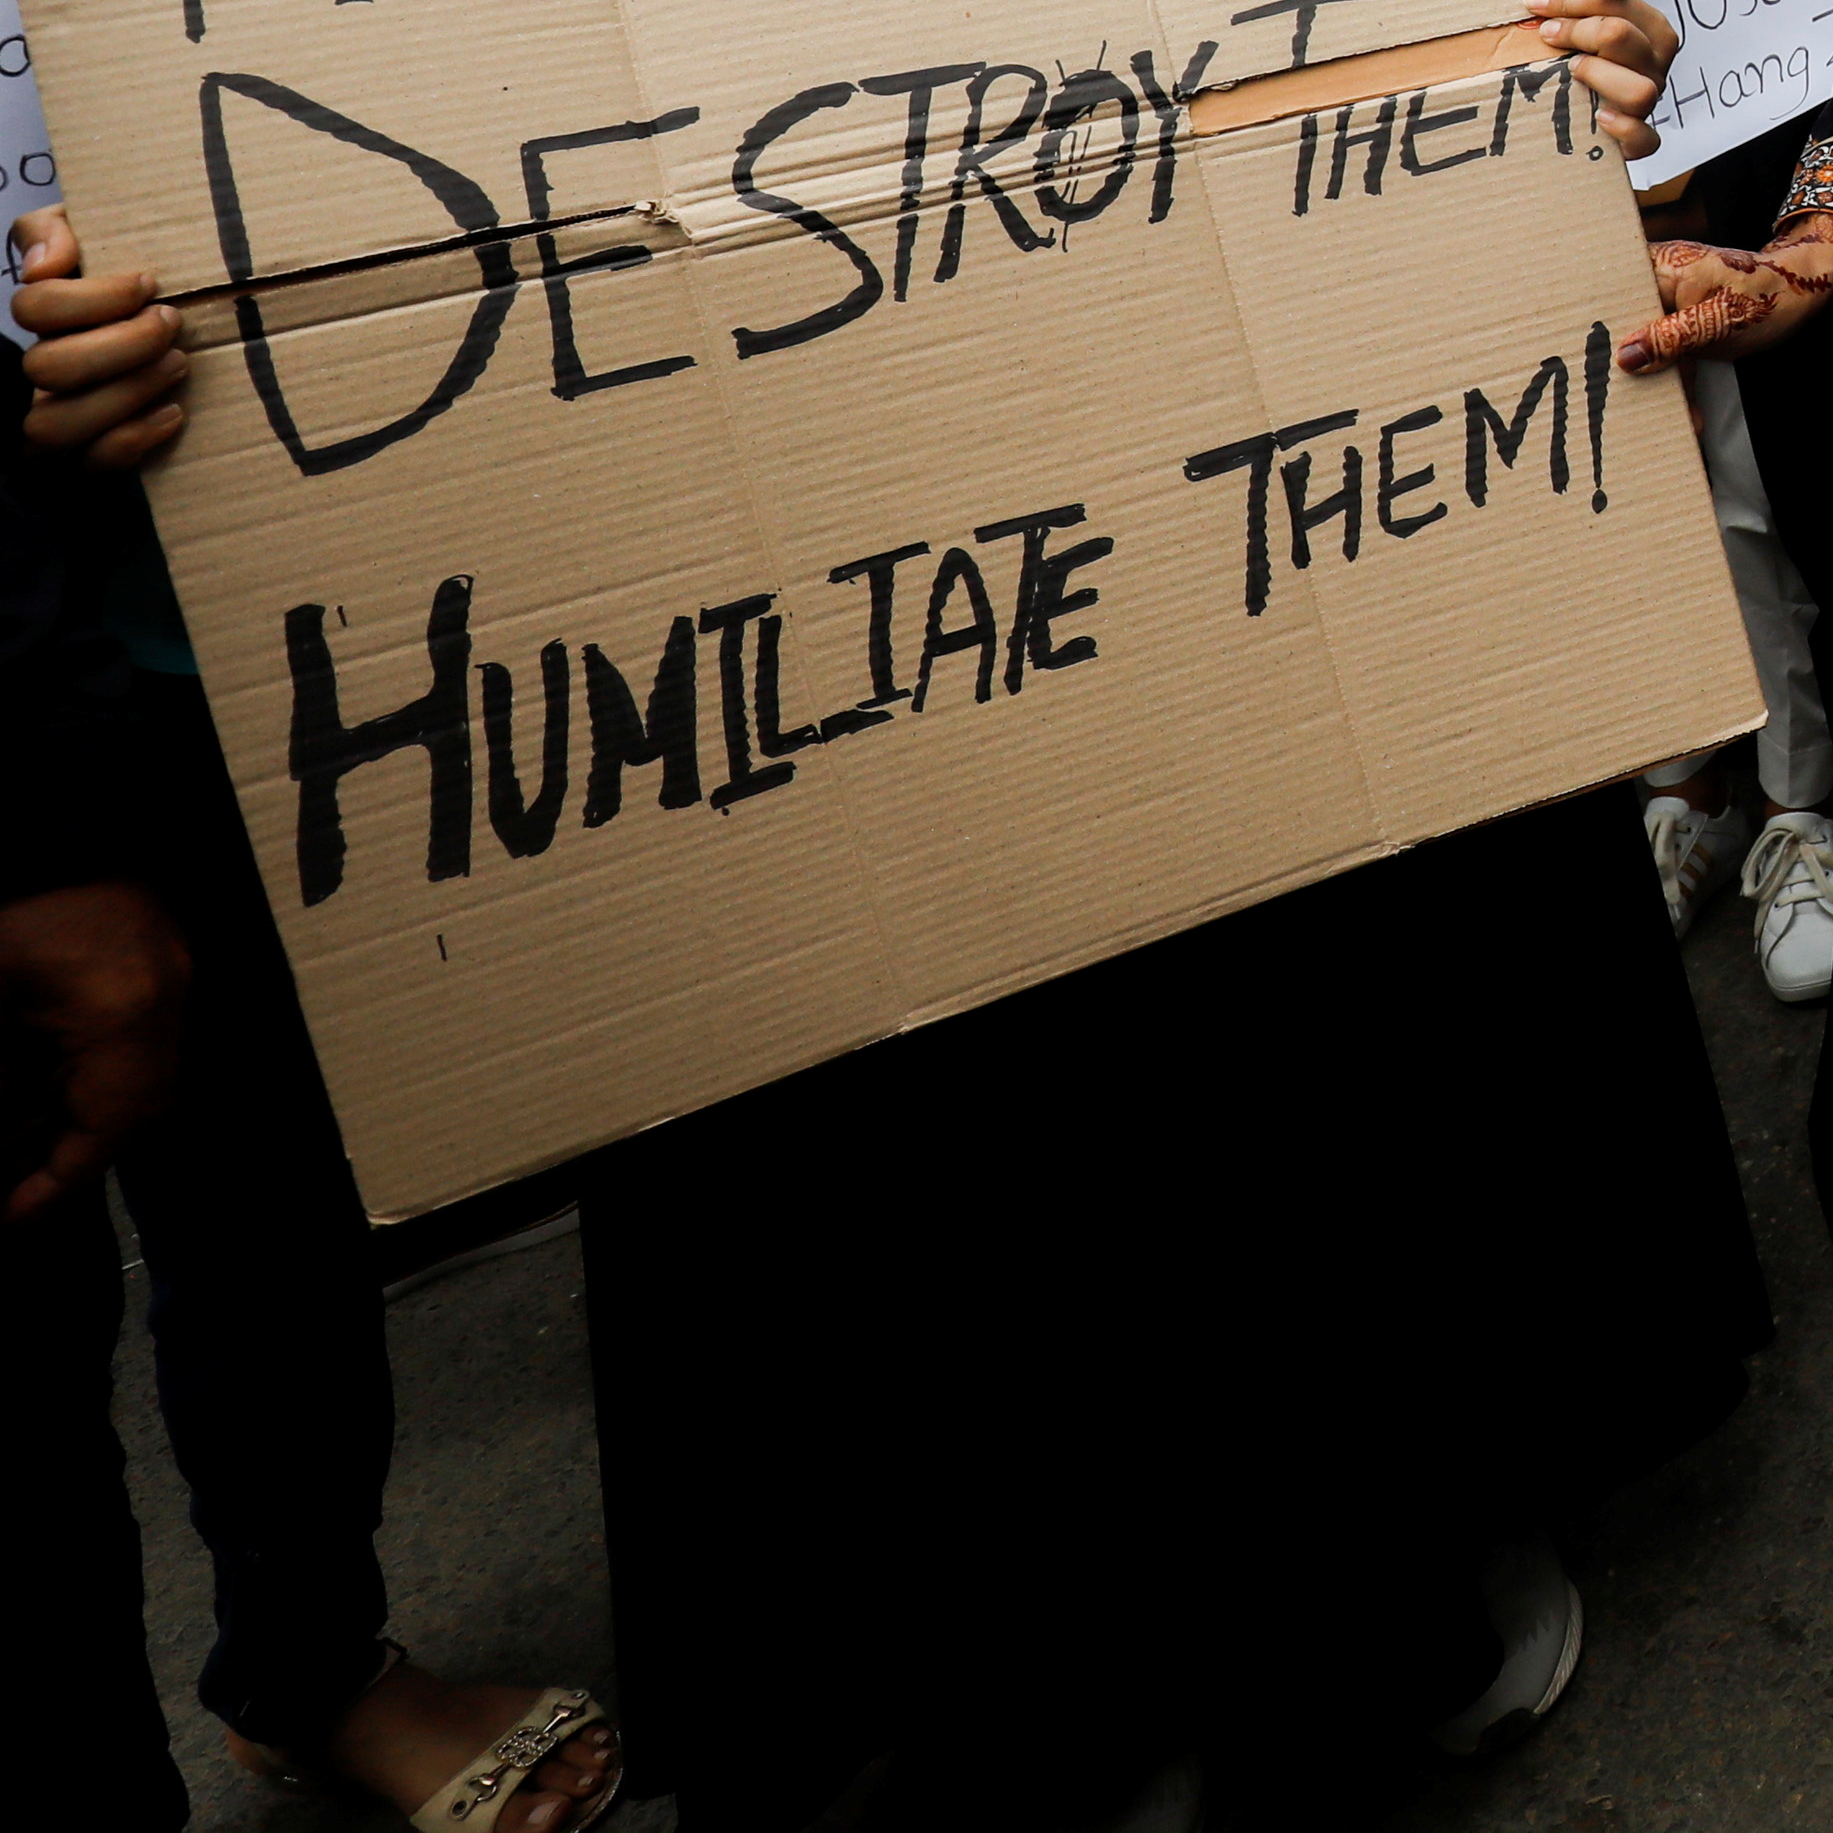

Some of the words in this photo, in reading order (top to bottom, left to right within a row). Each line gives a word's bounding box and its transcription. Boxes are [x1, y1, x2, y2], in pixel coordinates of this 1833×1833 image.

[200, 38, 1219, 476] DESTROY
[284, 502, 1114, 907] HUMILIATE
[1183, 320, 1612, 618] THEM!
